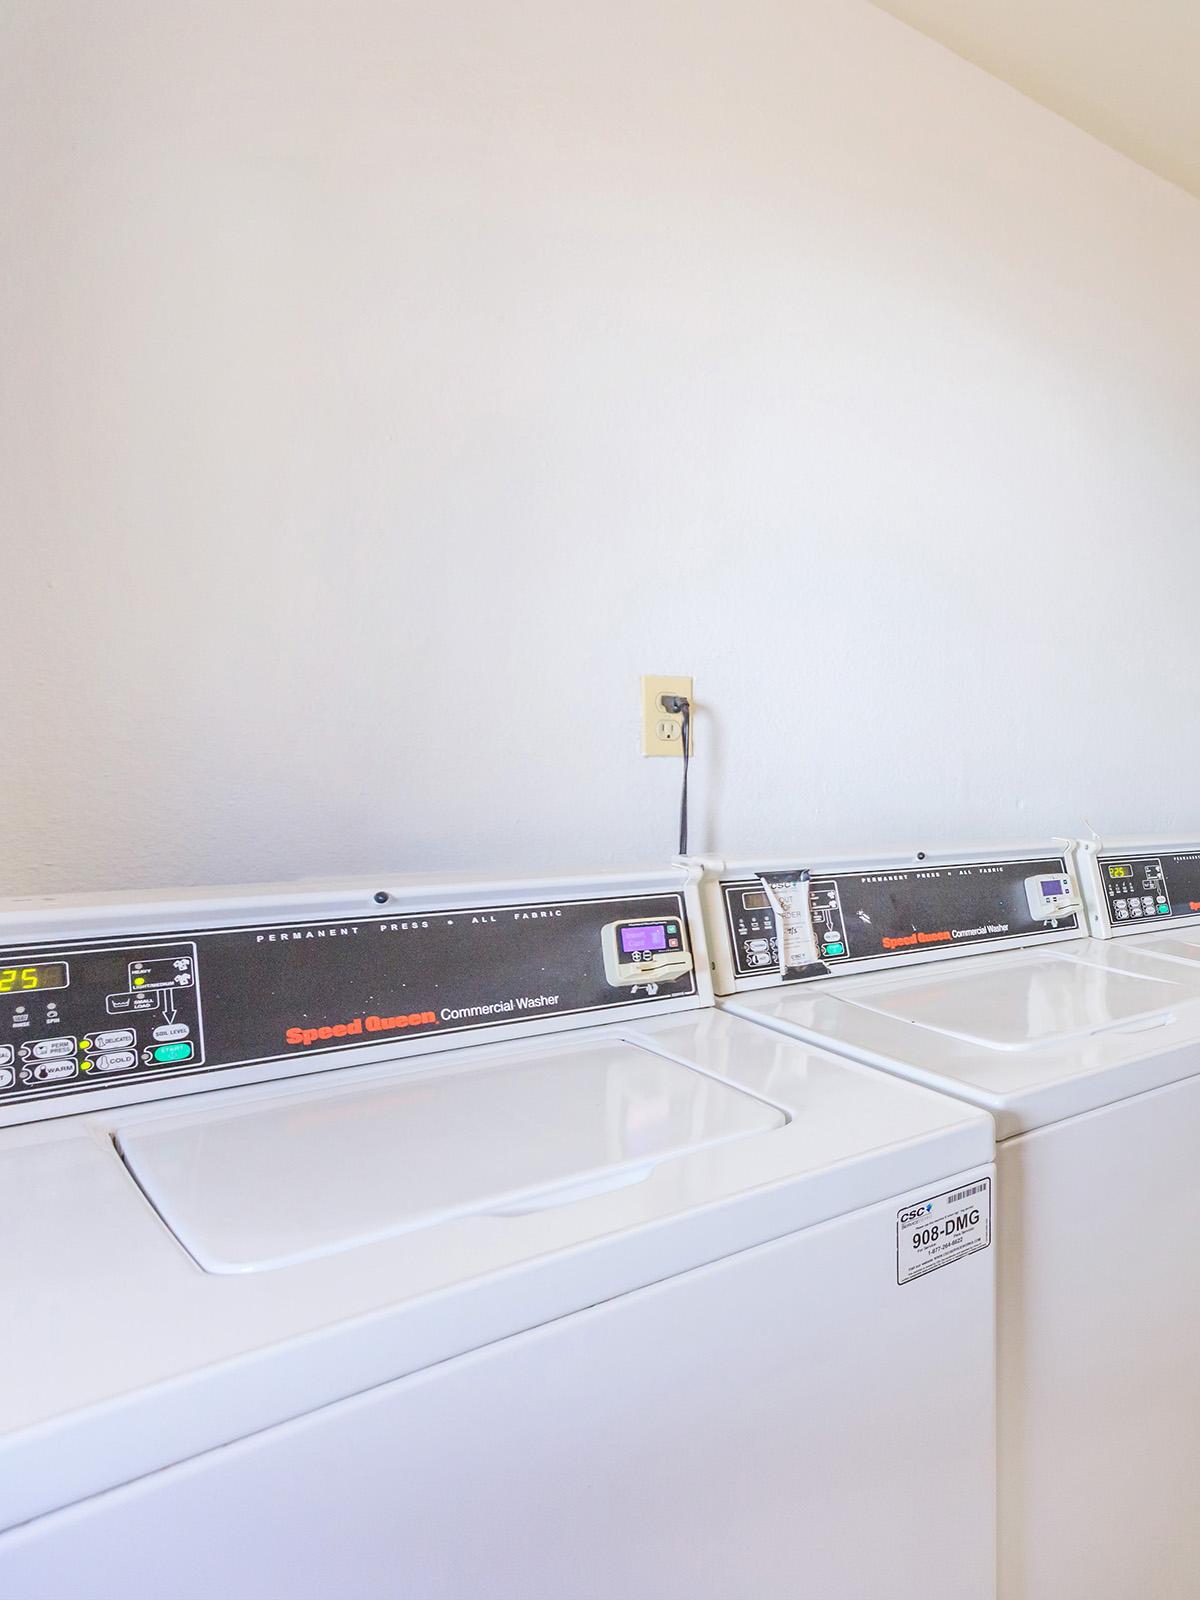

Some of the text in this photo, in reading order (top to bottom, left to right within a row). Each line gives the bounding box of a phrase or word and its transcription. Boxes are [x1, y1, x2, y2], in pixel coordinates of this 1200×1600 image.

[256, 909, 562, 942] PERMANENT PRESS ALL FABRIC
[882, 932, 918, 949] Speed
[951, 926, 987, 939] Commercial
[987, 923, 1009, 934] Washer
[286, 993, 560, 1046] Speed Queen Commercial Washer
[47, 1065, 74, 1074] WARM
[109, 1056, 132, 1065] COLD
[900, 1207, 925, 1223] CSC
[912, 1209, 980, 1249] 908-DMG
